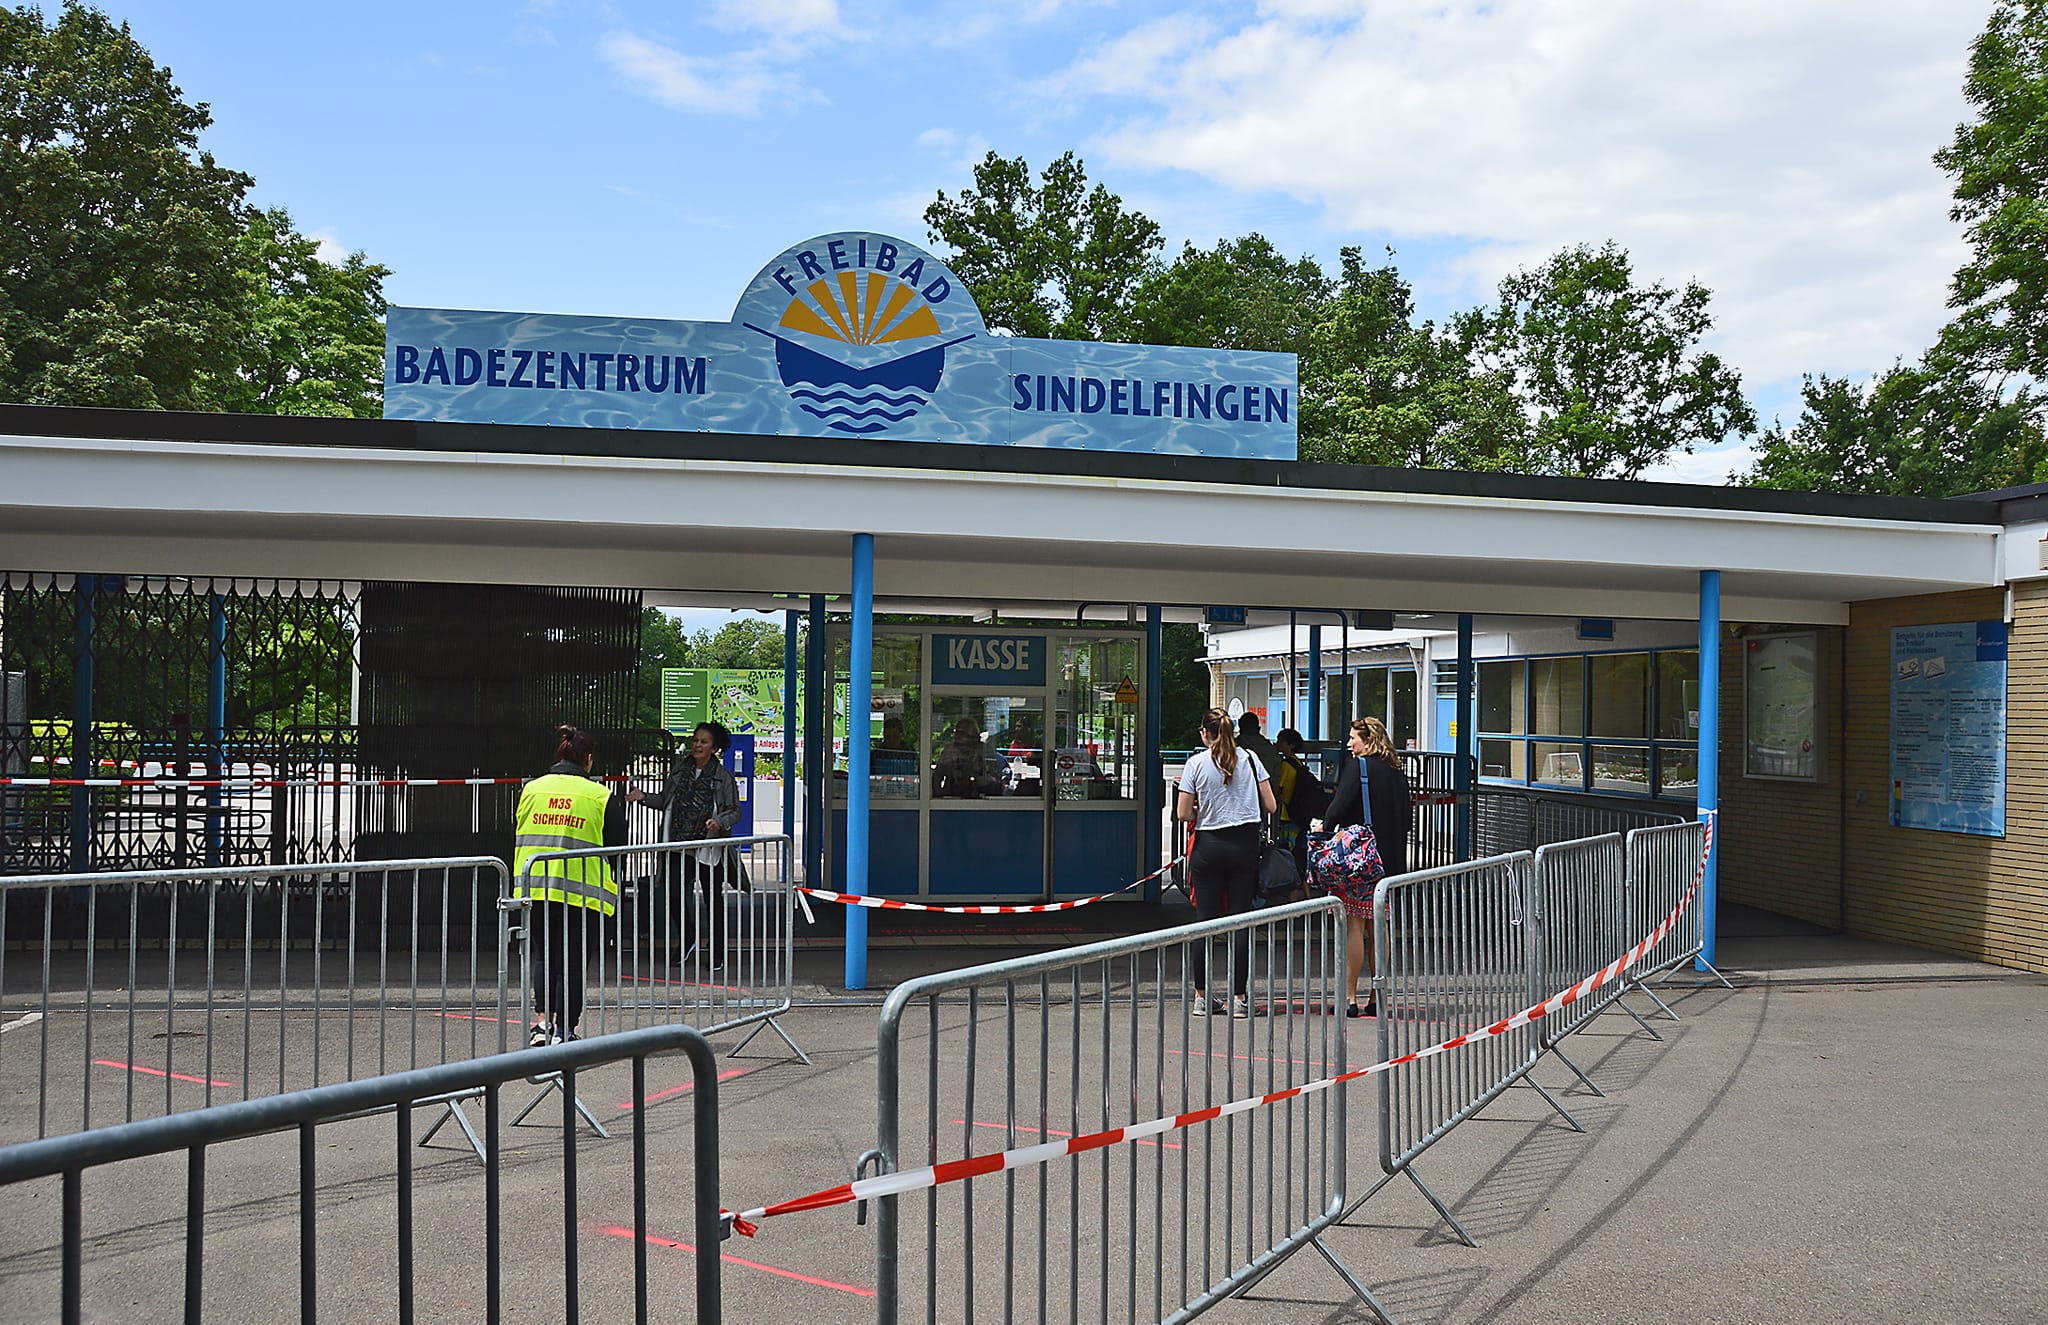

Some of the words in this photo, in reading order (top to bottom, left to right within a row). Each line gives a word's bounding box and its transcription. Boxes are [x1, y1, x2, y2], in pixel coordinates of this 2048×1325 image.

[772, 239, 951, 304] FREIBAD
[395, 345, 707, 395] BADEZENTRUM
[1013, 373, 1288, 424] SINDELFINGEN
[948, 638, 1030, 671] KASSE
[759, 740, 779, 749] Anlage
[548, 797, 573, 810] M3S
[532, 812, 586, 830] SICHERHEIT
